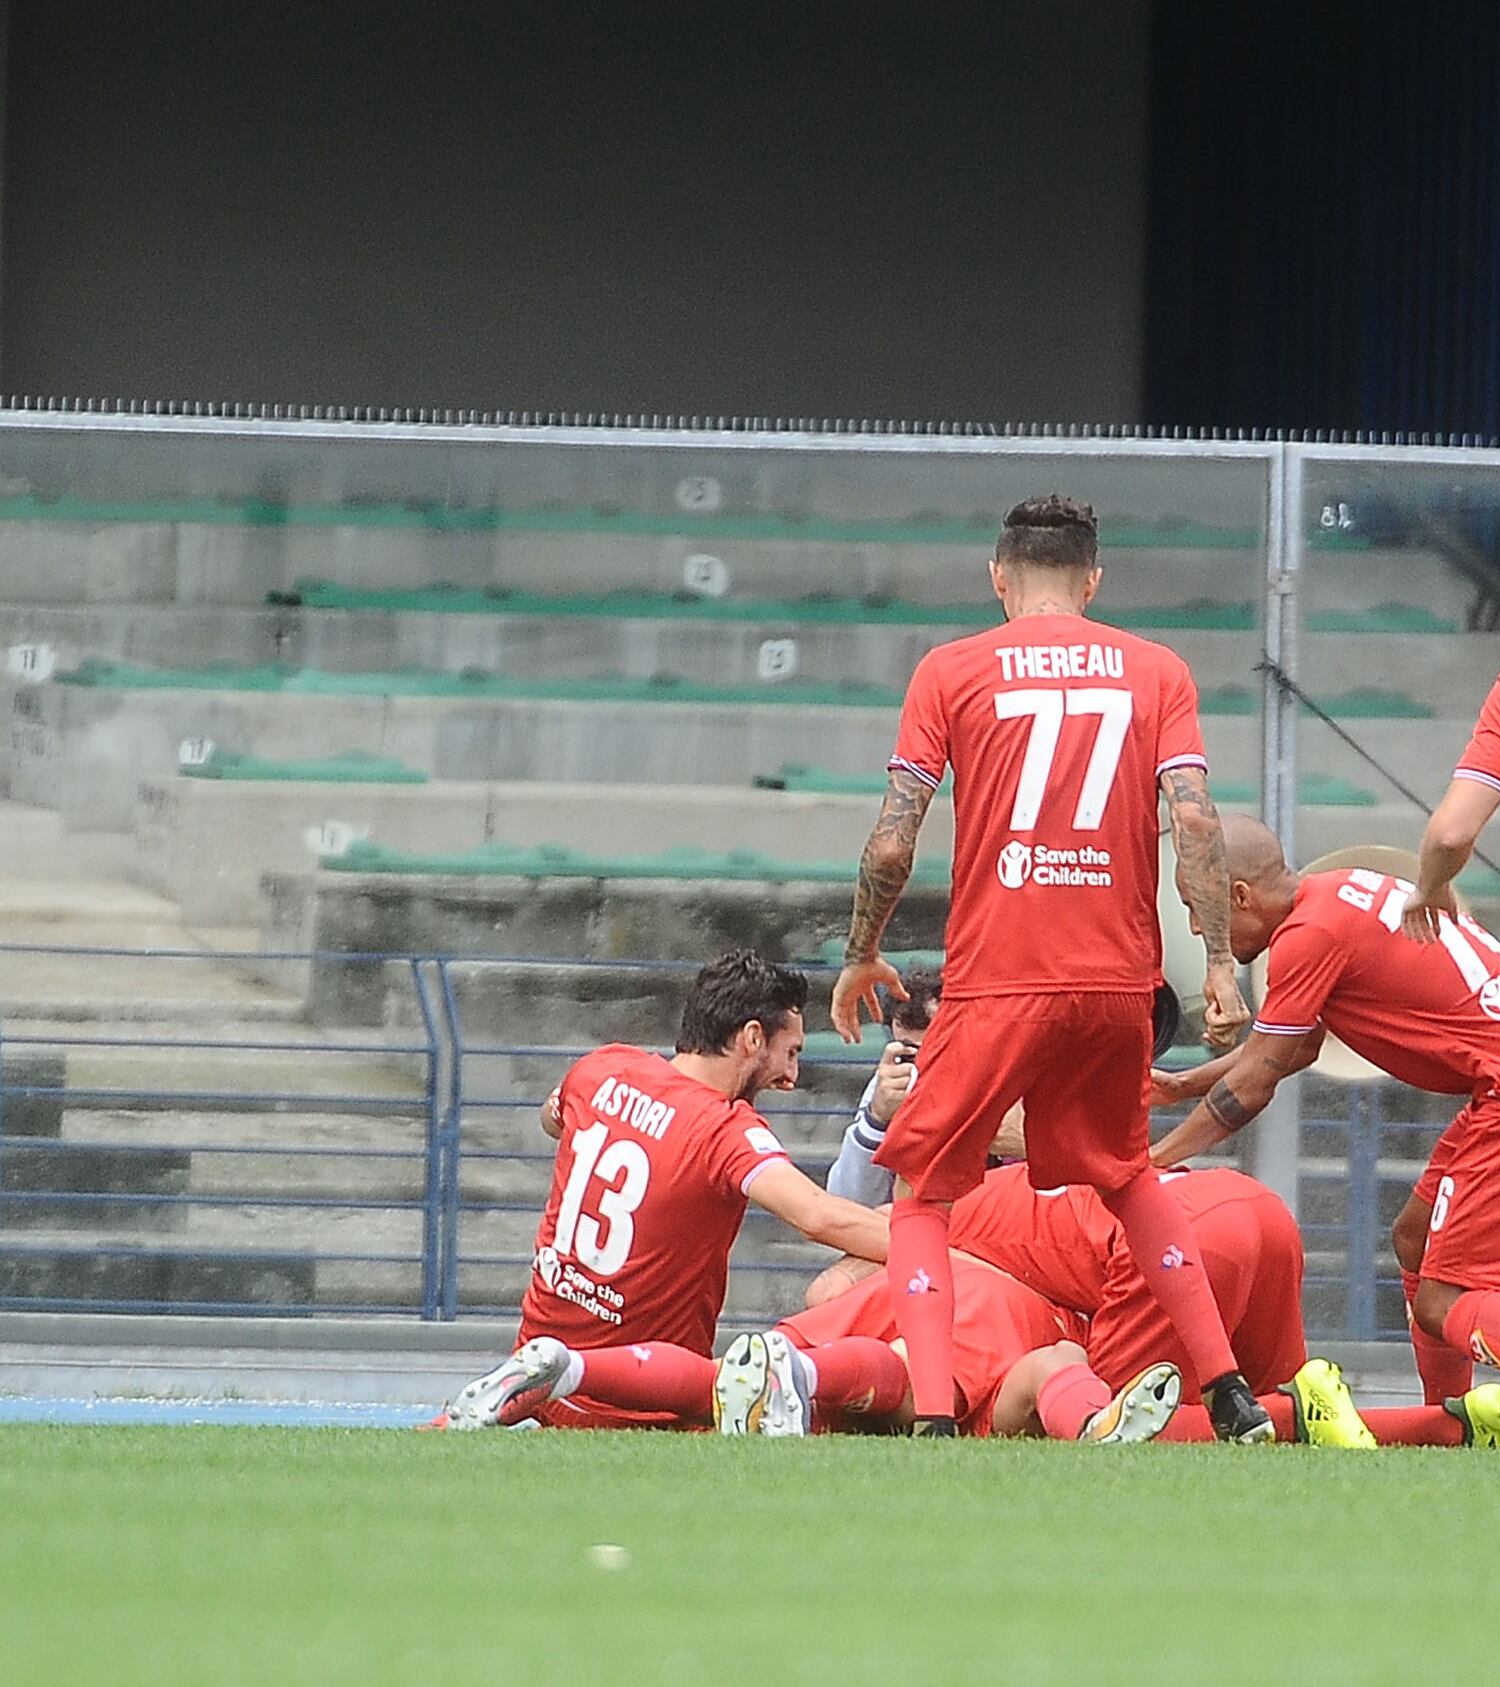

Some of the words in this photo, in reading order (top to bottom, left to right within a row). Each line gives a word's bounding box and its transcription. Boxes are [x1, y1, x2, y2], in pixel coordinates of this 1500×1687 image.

[994, 643, 1124, 682] THEREAU
[994, 687, 1133, 831] 77
[1032, 866, 1111, 886] Children
[1034, 845, 1078, 864] Save
[1078, 845, 1110, 865] the
[591, 1076, 676, 1140] ASTORI
[550, 1120, 650, 1276] 13
[556, 1281, 622, 1325] Children
[563, 1264, 595, 1294] Save
[597, 1285, 624, 1308] the
